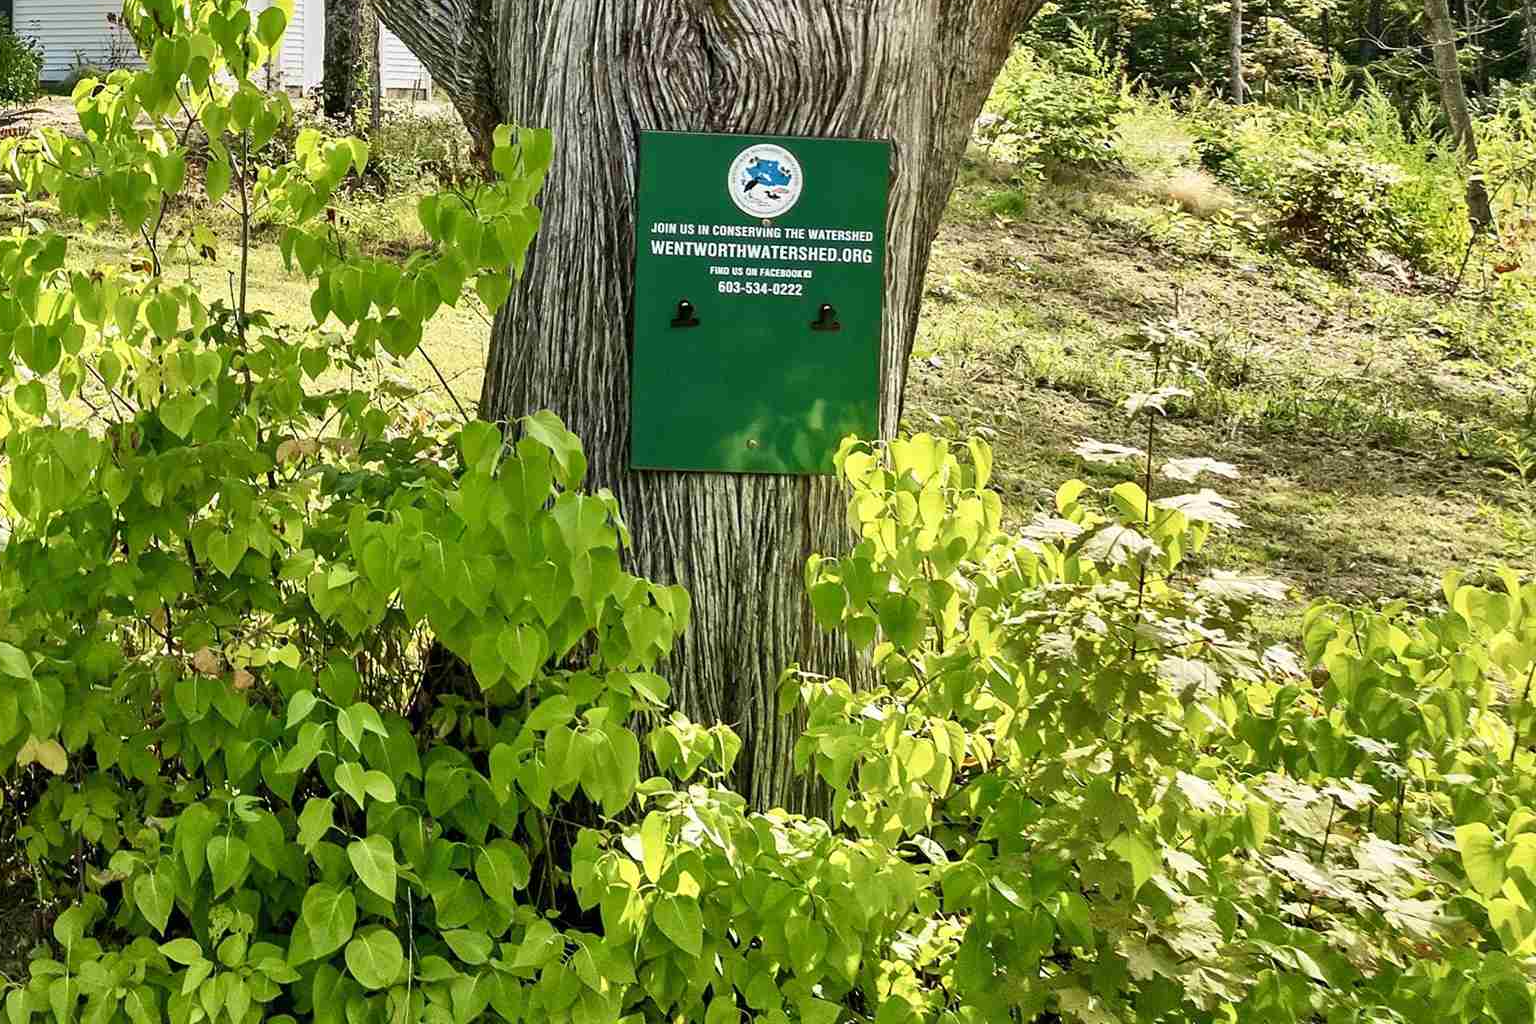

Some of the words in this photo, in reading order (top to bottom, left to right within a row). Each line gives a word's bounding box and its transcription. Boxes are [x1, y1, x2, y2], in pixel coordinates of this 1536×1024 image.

[651, 222, 676, 234] JOIN
[680, 223, 695, 235] US
[698, 224, 709, 235] IN
[712, 225, 781, 238] CONSERVING
[784, 228, 805, 239] THE
[808, 229, 873, 242] WATERSHED
[651, 239, 873, 263] WENTWORTHWATERSHED.ORG
[732, 267, 743, 276] US
[759, 268, 802, 278] FACEBOOK
[718, 281, 802, 296] 603-534-0222
